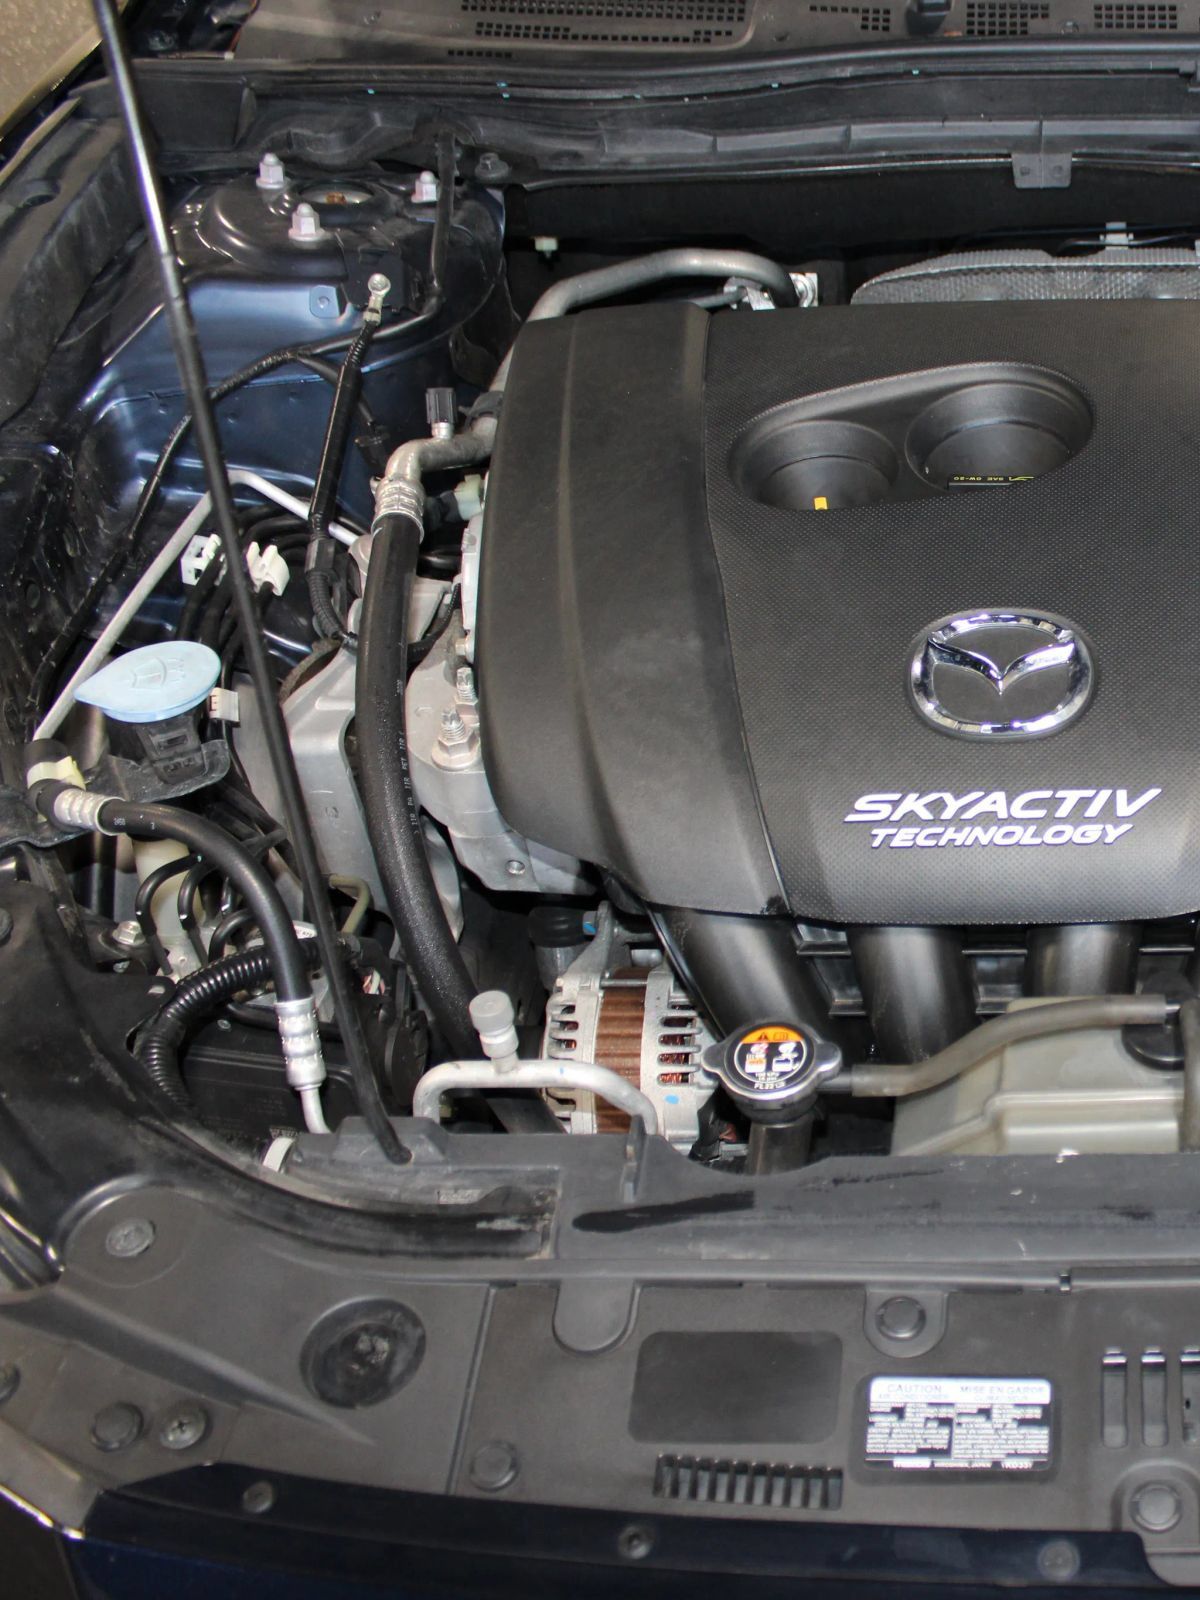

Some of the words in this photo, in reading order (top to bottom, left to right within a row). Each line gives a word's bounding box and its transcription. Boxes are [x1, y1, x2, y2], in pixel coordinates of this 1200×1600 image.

[844, 788, 1163, 823] SKYACTIV
[870, 823, 1135, 849] TECHNOLOGY
[887, 1384, 942, 1393] CAUTION
[960, 1385, 986, 1393] MISE
[989, 1386, 1004, 1394] EN
